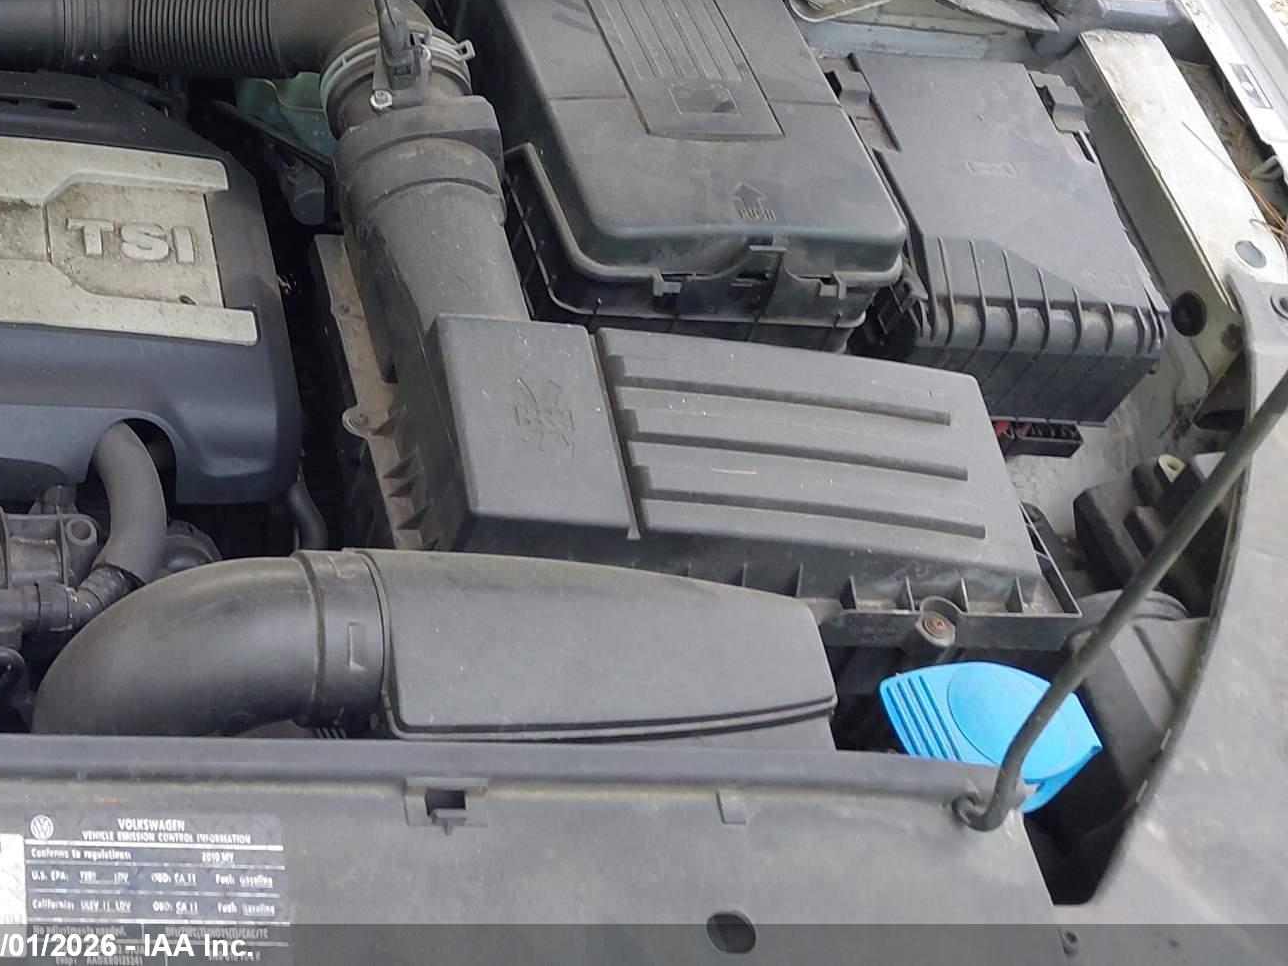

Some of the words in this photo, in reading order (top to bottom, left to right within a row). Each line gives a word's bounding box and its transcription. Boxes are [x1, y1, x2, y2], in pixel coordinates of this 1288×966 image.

[66, 217, 195, 264] TSI
[118, 819, 185, 832] VOLKSWAGEN
[82, 830, 114, 841] VEHICLE
[117, 831, 155, 842] EMISSION
[158, 833, 193, 843] CONTROL
[197, 834, 251, 845] INFORMATION
[31, 848, 69, 859] Conforms
[72, 849, 81, 859] to
